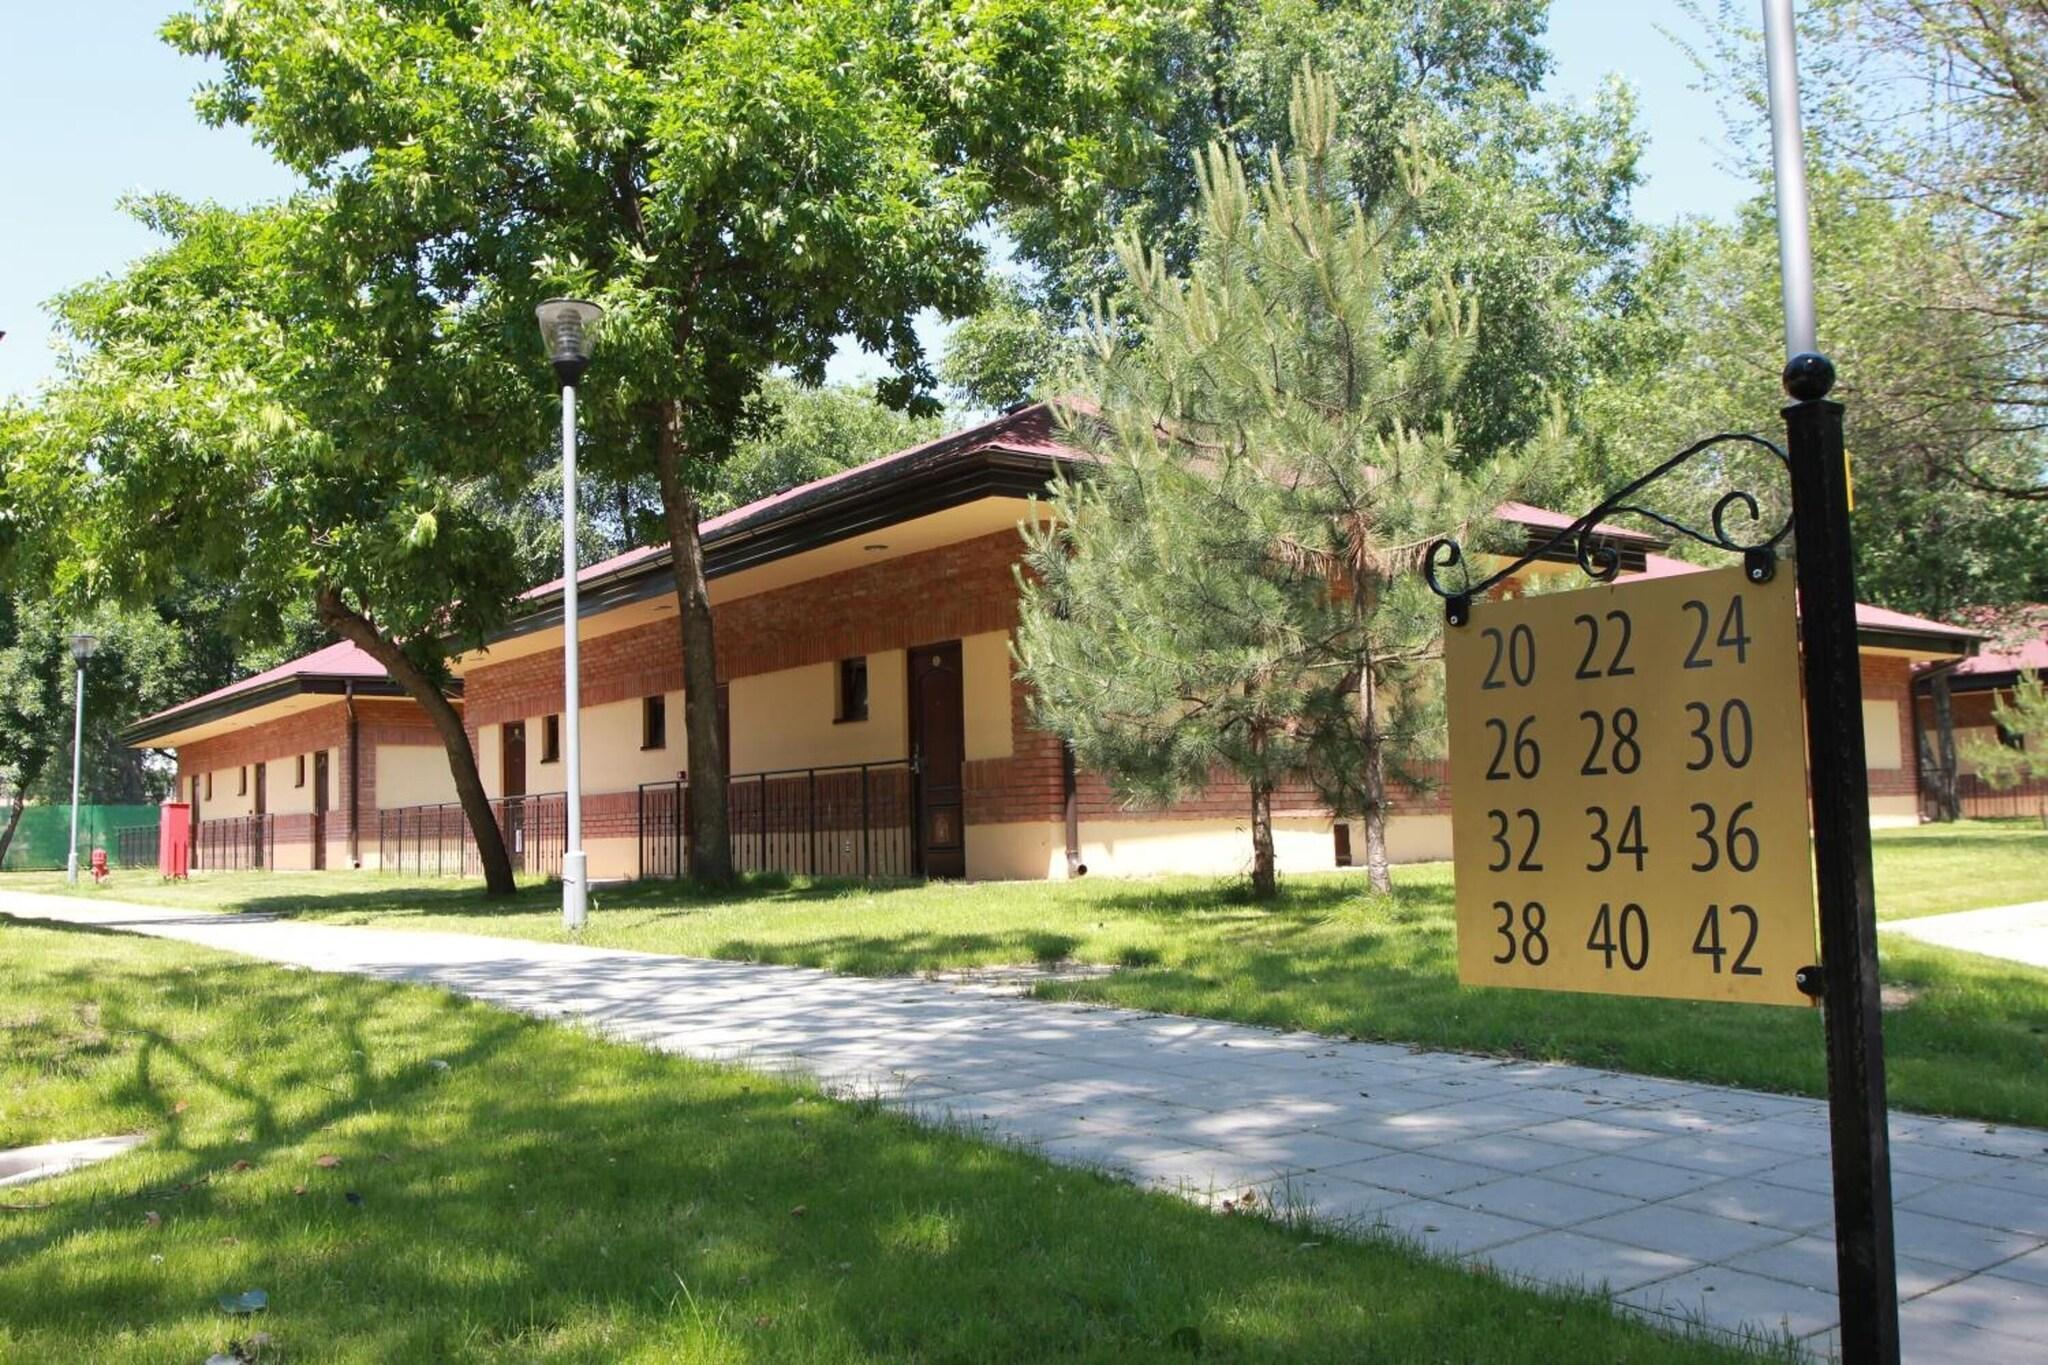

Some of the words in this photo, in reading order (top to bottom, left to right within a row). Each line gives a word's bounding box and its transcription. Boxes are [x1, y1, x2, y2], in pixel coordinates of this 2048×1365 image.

[1480, 623, 1537, 691] 20
[1573, 609, 1636, 681] 22
[1681, 594, 1752, 669] 24
[1484, 714, 1541, 781] 26
[1579, 706, 1642, 777] 28
[1685, 698, 1753, 772] 30
[1487, 808, 1544, 873] 32
[1585, 805, 1649, 872] 34
[1690, 801, 1760, 873] 36
[1492, 901, 1549, 966] 38
[1586, 902, 1650, 971] 40
[1692, 904, 1763, 976] 42
